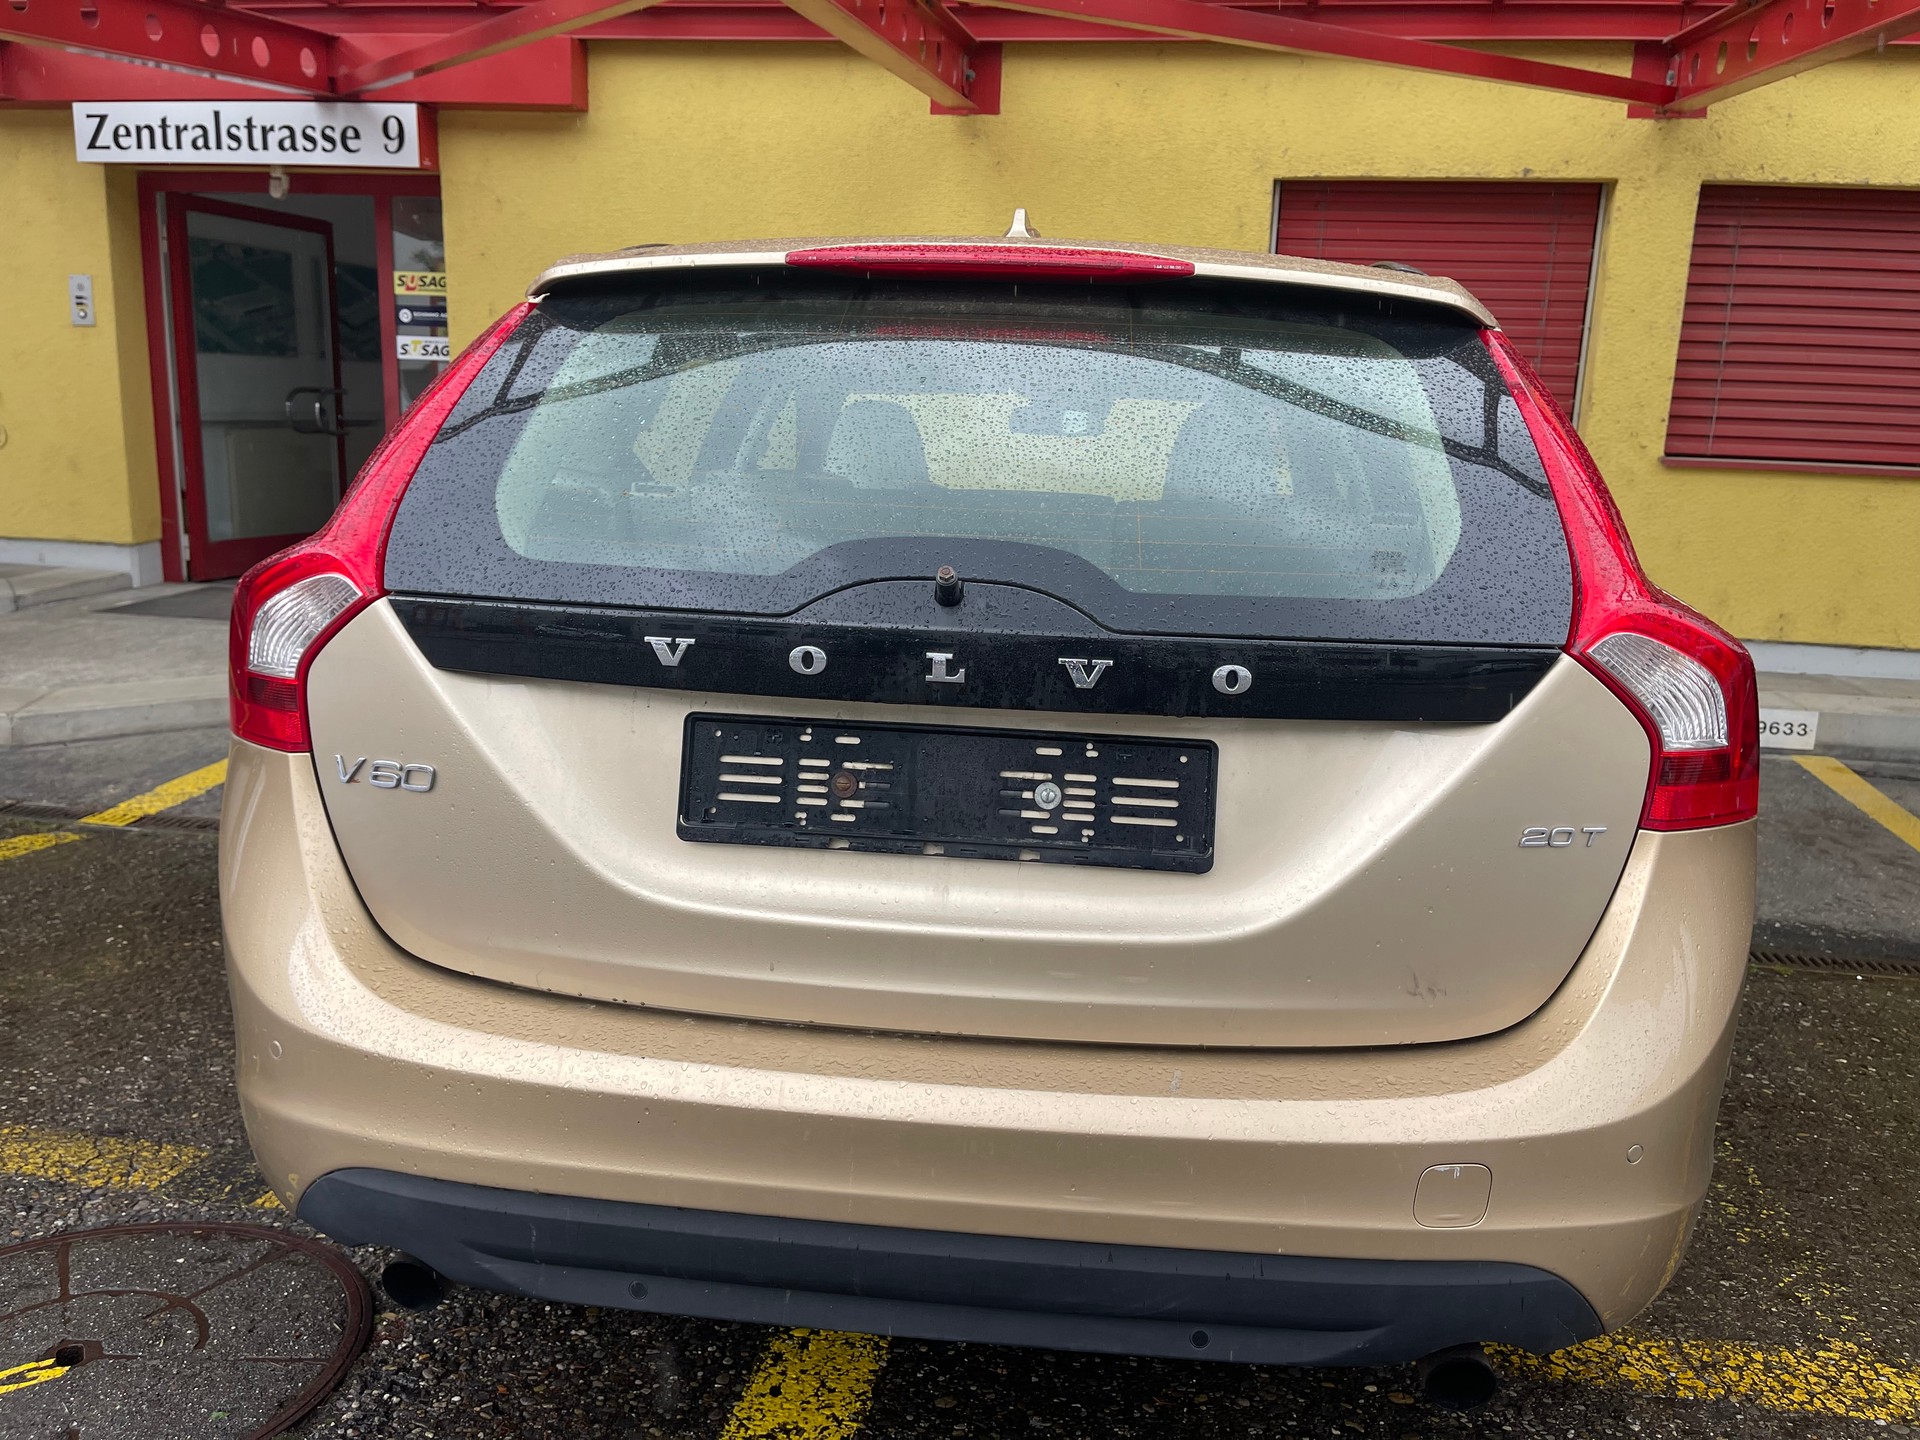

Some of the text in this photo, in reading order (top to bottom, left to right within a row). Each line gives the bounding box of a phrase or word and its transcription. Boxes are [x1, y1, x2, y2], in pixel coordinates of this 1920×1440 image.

[86, 110, 405, 154] Zentralstrasse 9
[397, 274, 447, 291] SUSAG
[644, 636, 1253, 695] VOLVO
[334, 754, 436, 793] V60
